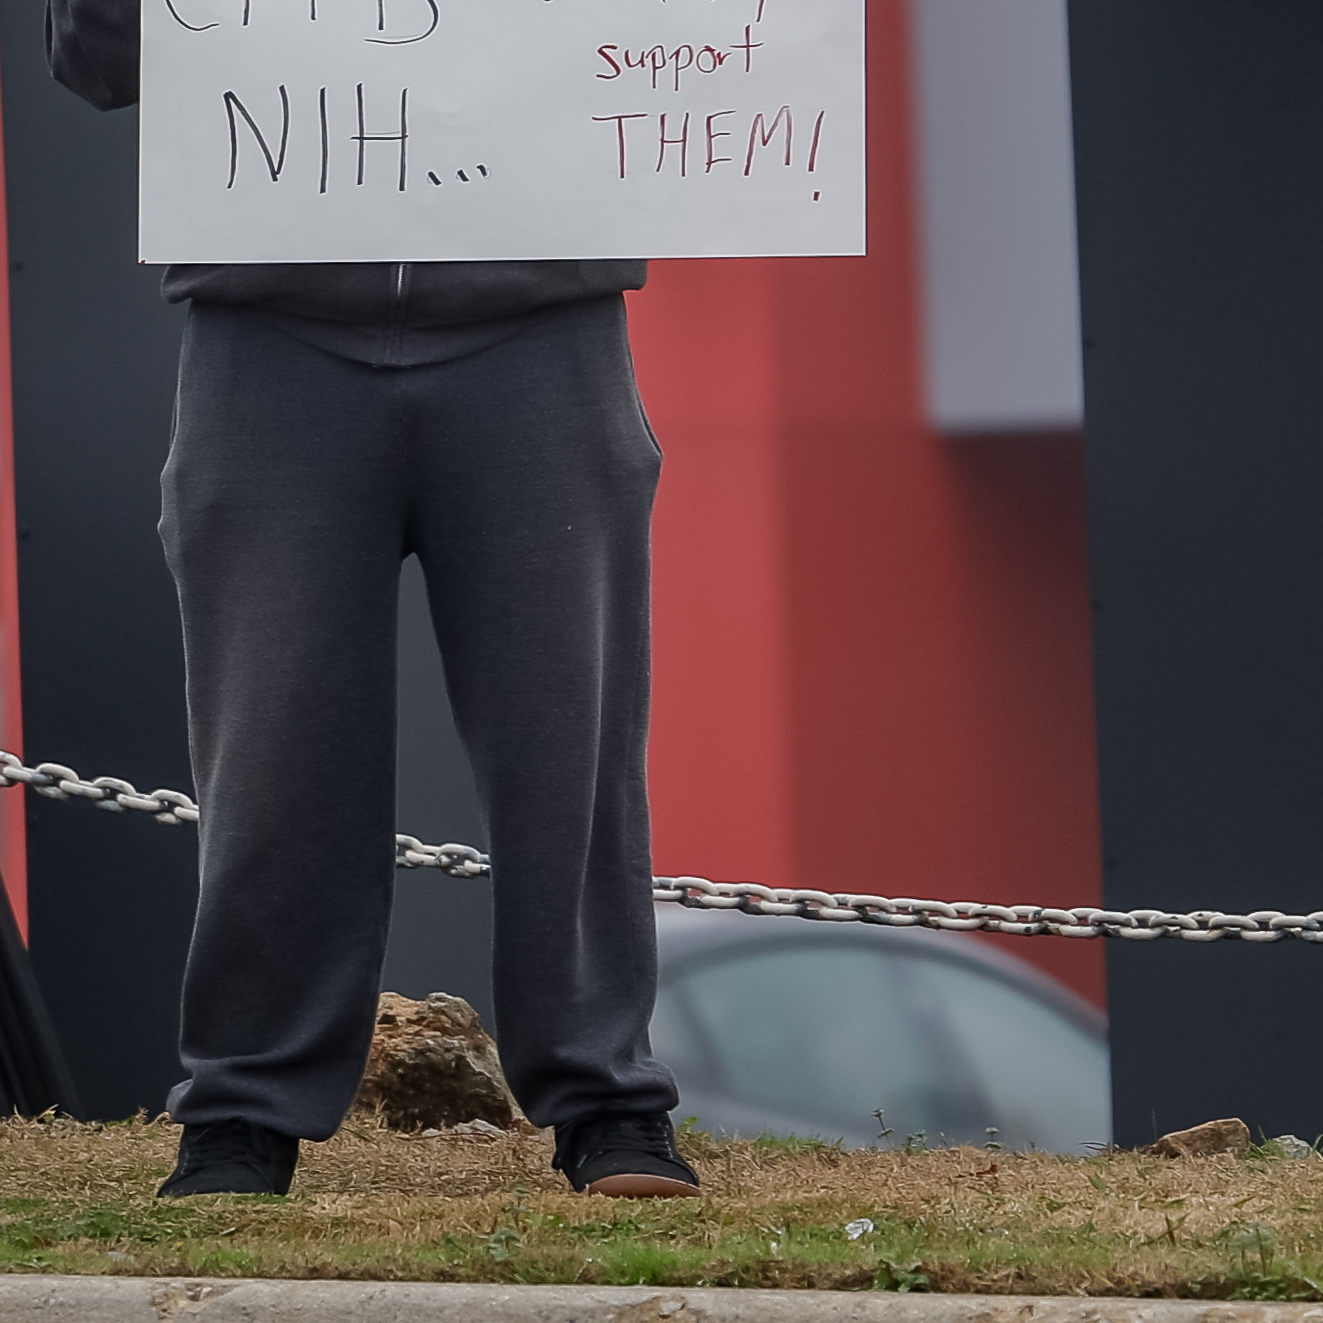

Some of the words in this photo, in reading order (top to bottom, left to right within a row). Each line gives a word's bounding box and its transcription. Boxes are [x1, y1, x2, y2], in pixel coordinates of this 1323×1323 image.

[595, 24, 764, 92] support
[223, 82, 490, 194] NIH...
[591, 105, 826, 202] THEM!
